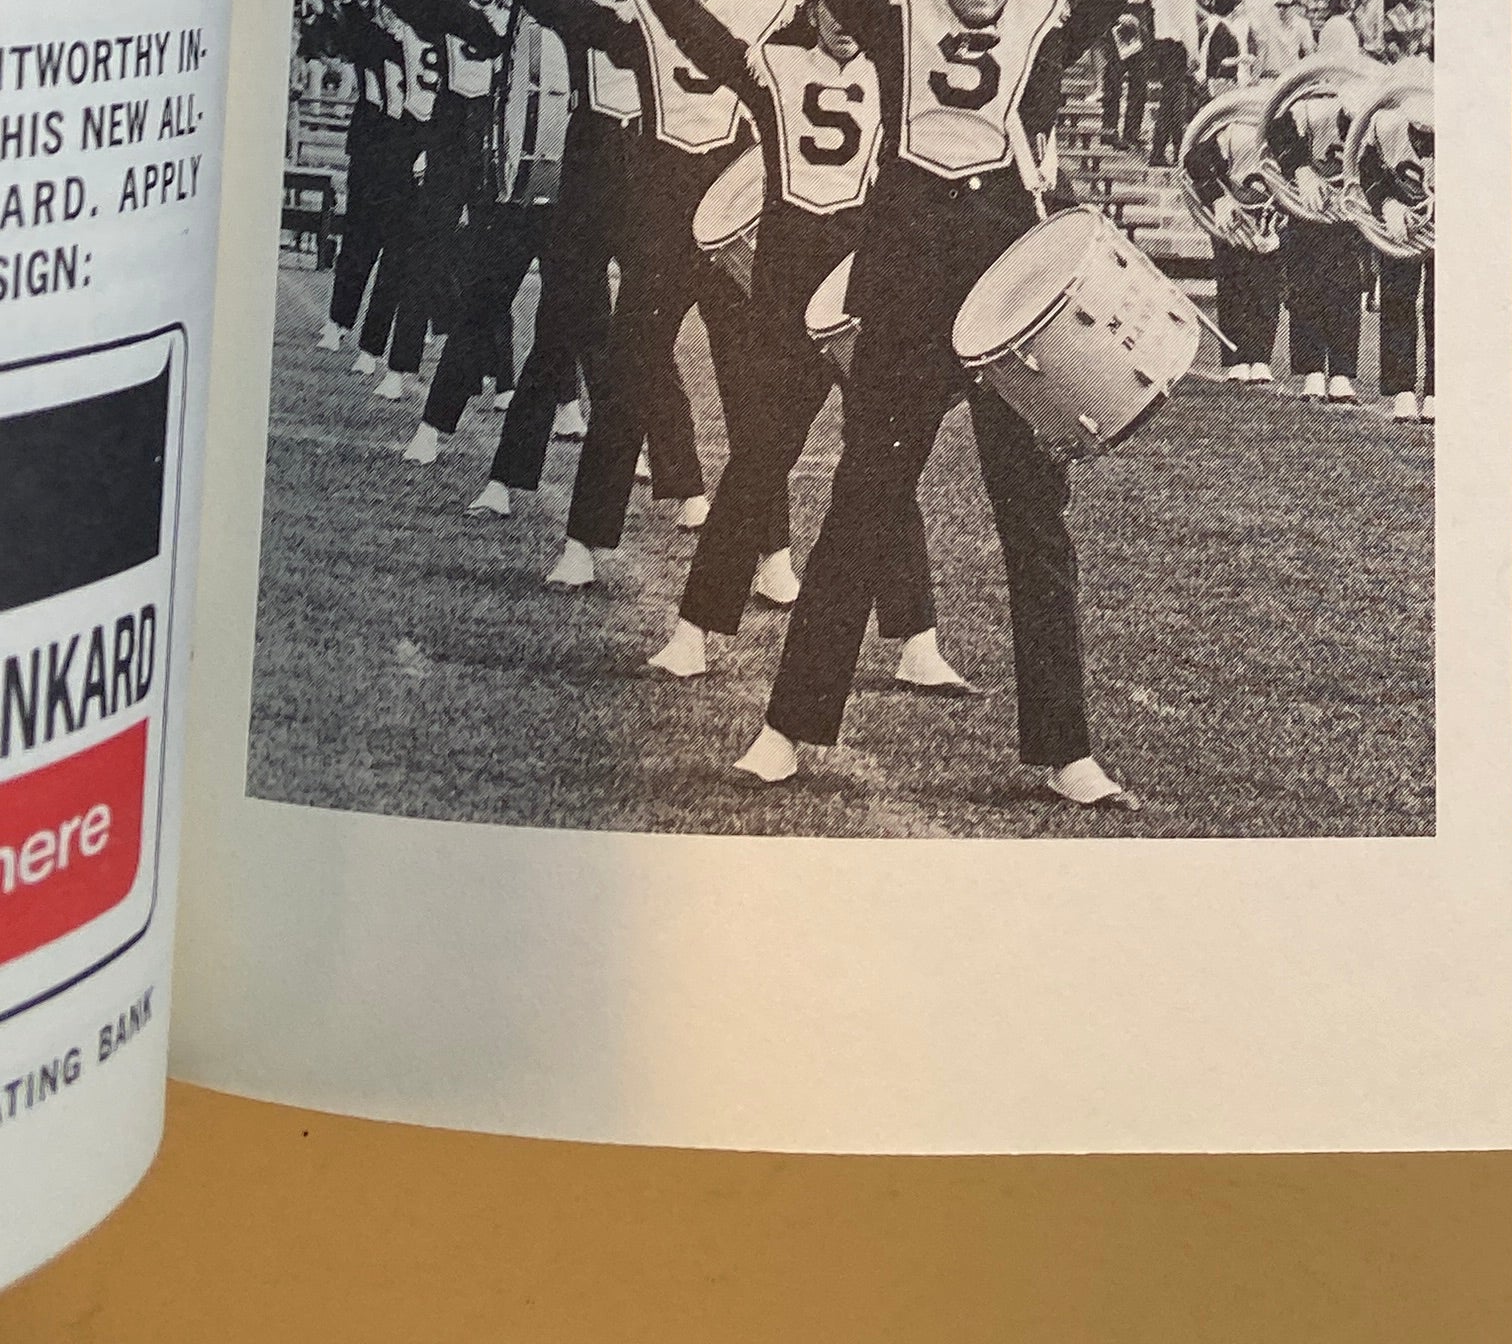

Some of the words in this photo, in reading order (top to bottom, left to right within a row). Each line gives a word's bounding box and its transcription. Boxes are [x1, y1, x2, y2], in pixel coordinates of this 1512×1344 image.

[177, 28, 208, 74] IN-
[80, 99, 149, 151] NEW
[157, 93, 204, 141] ALL-
[118, 154, 203, 213] APPLY
[0, 1046, 82, 1124] TING
